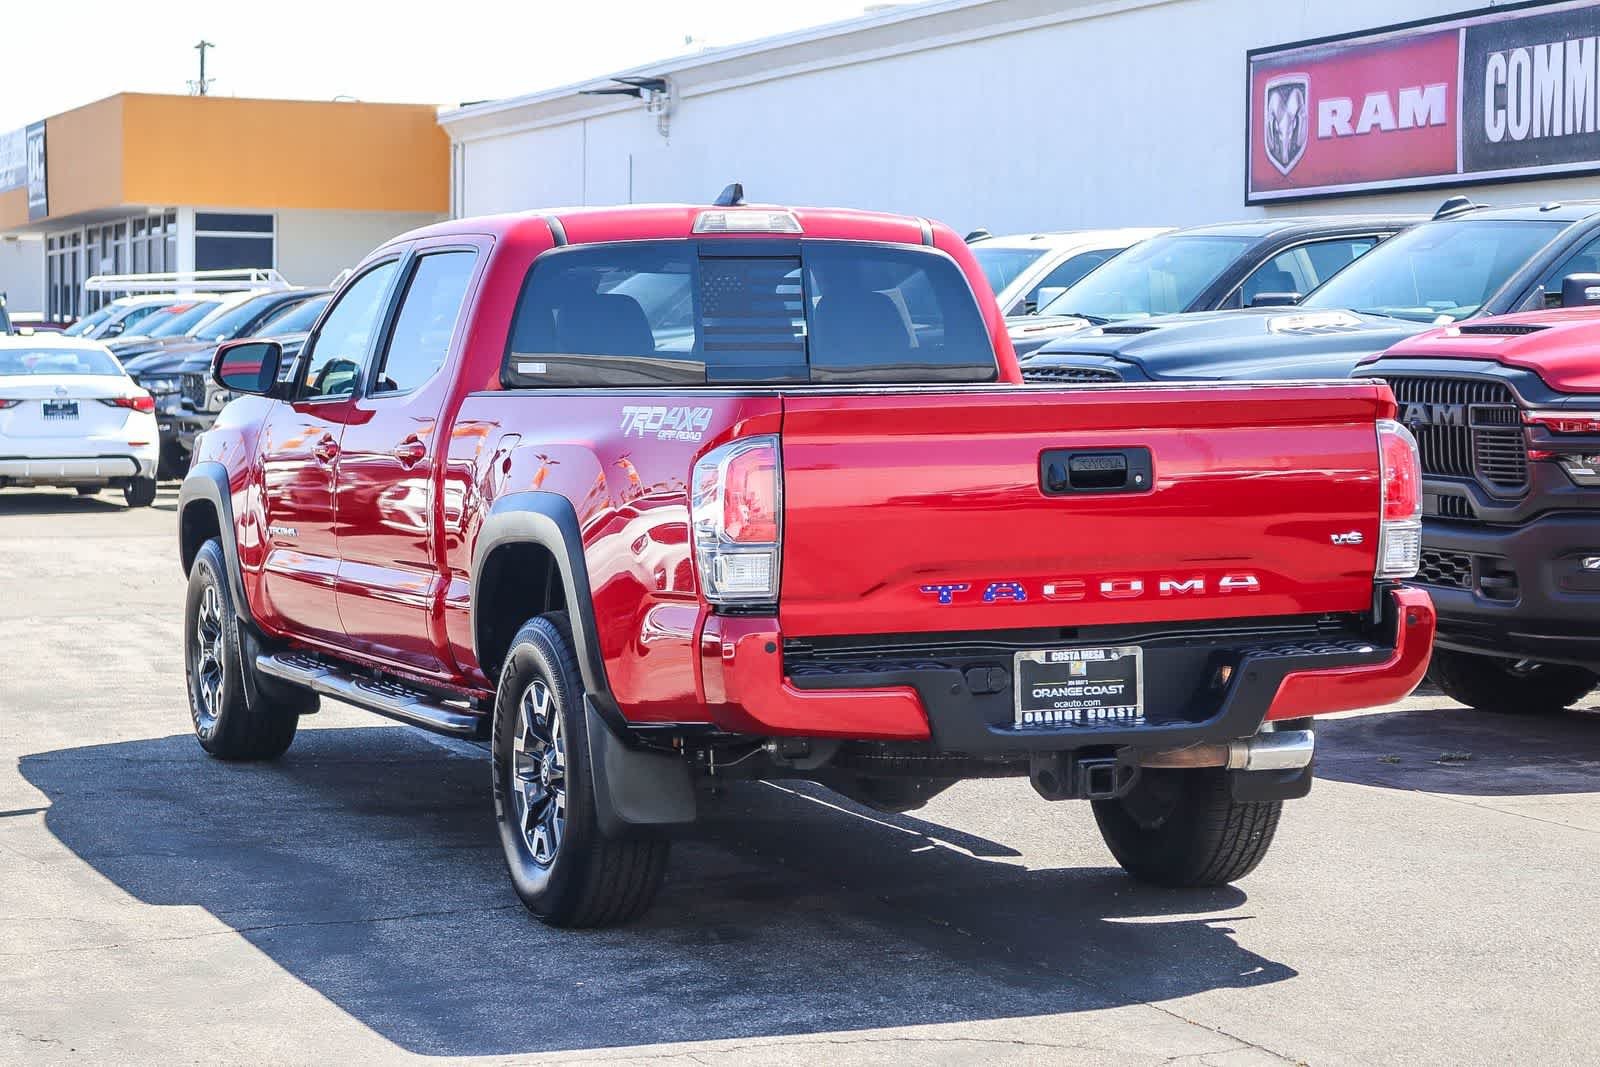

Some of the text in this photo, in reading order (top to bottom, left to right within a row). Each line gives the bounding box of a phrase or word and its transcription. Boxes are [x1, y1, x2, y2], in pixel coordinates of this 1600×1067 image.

[1484, 36, 1600, 142] COMM
[1317, 83, 1448, 139] RAM
[620, 405, 666, 438] TRD
[1400, 401, 1464, 426] AM
[677, 431, 701, 442] ROAD
[919, 574, 1260, 604] TACOMA
[1051, 649, 1105, 661] COSTA MESA
[1024, 707, 1135, 722] ORANGE COAST
[1054, 699, 1101, 708] ocauto.com
